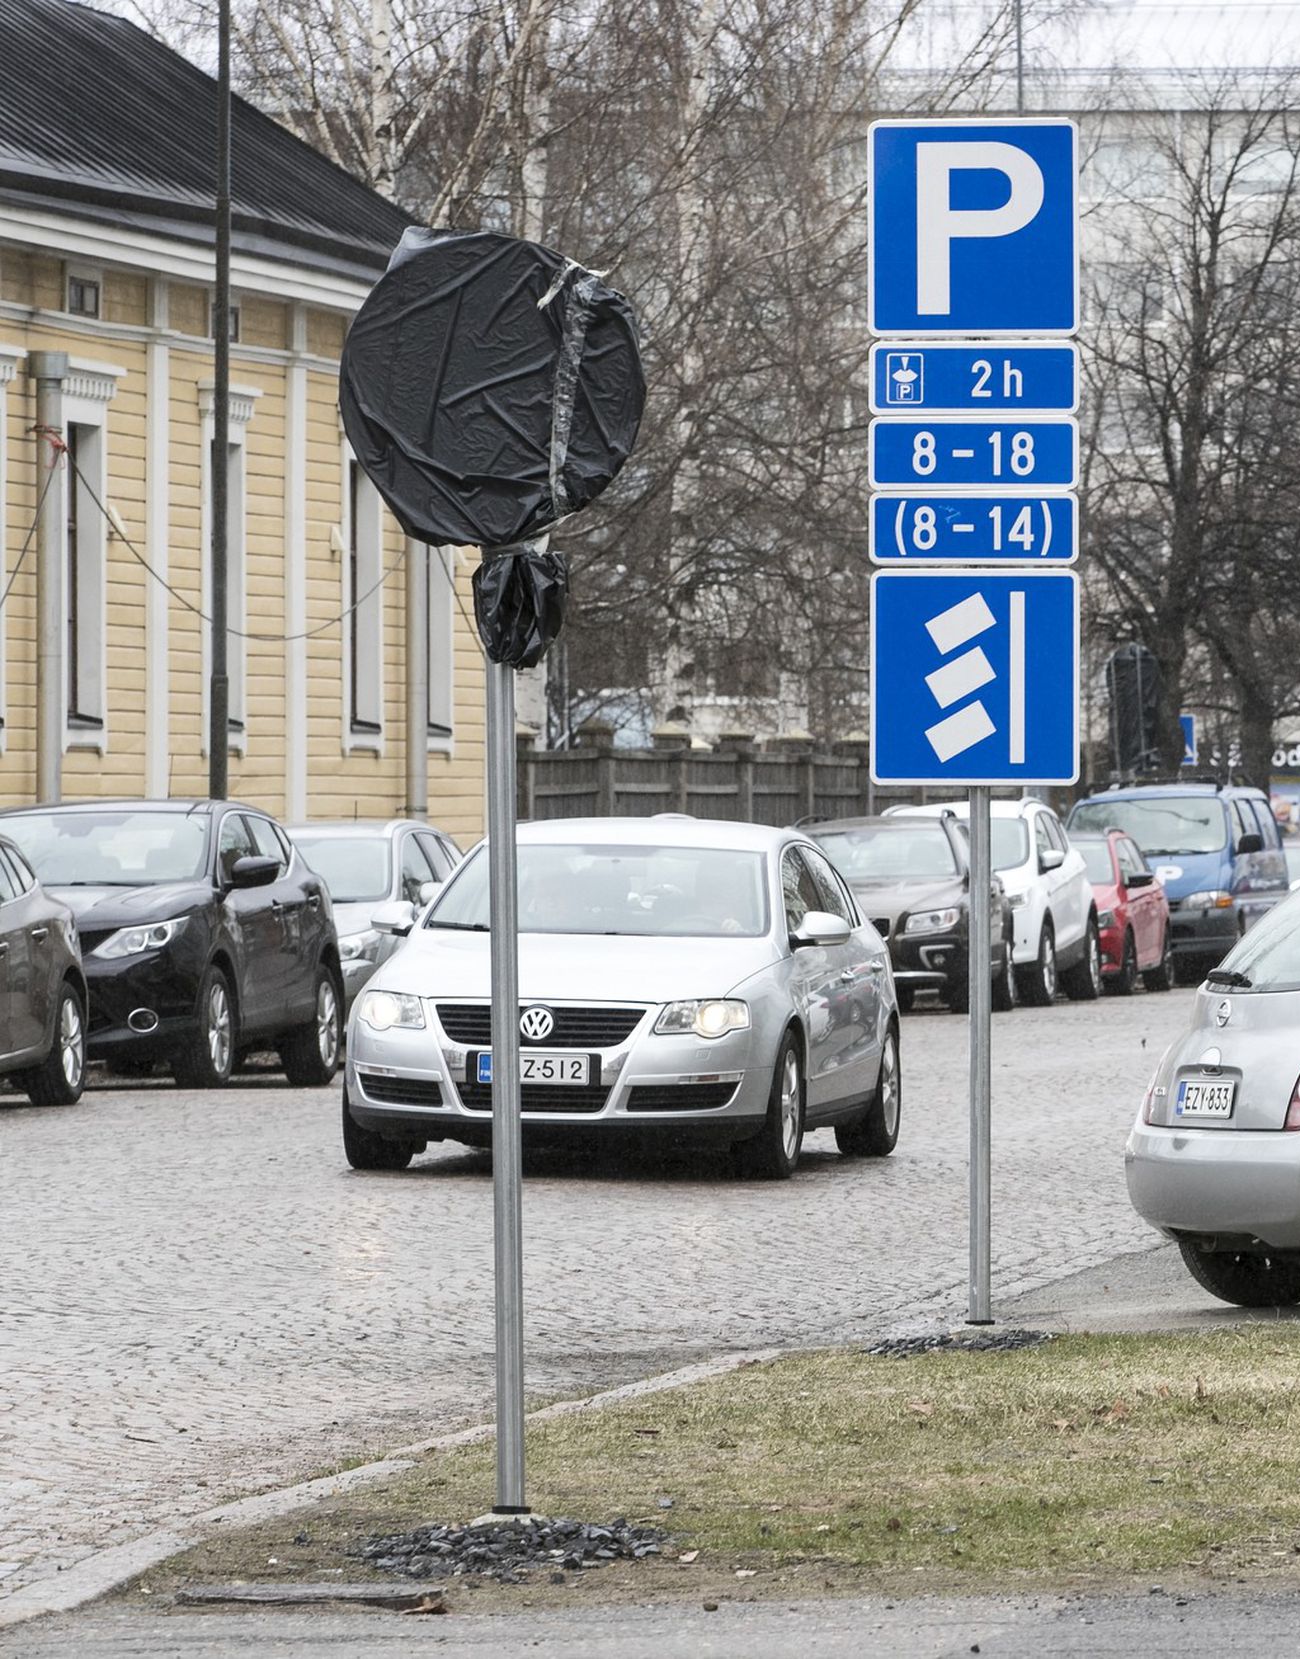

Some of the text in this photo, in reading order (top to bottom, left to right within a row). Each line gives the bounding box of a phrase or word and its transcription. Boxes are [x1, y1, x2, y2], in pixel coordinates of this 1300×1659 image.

[917, 141, 1045, 315] P
[523, 1060, 582, 1080] Z-512
[1185, 1087, 1229, 1110] EZY-833
